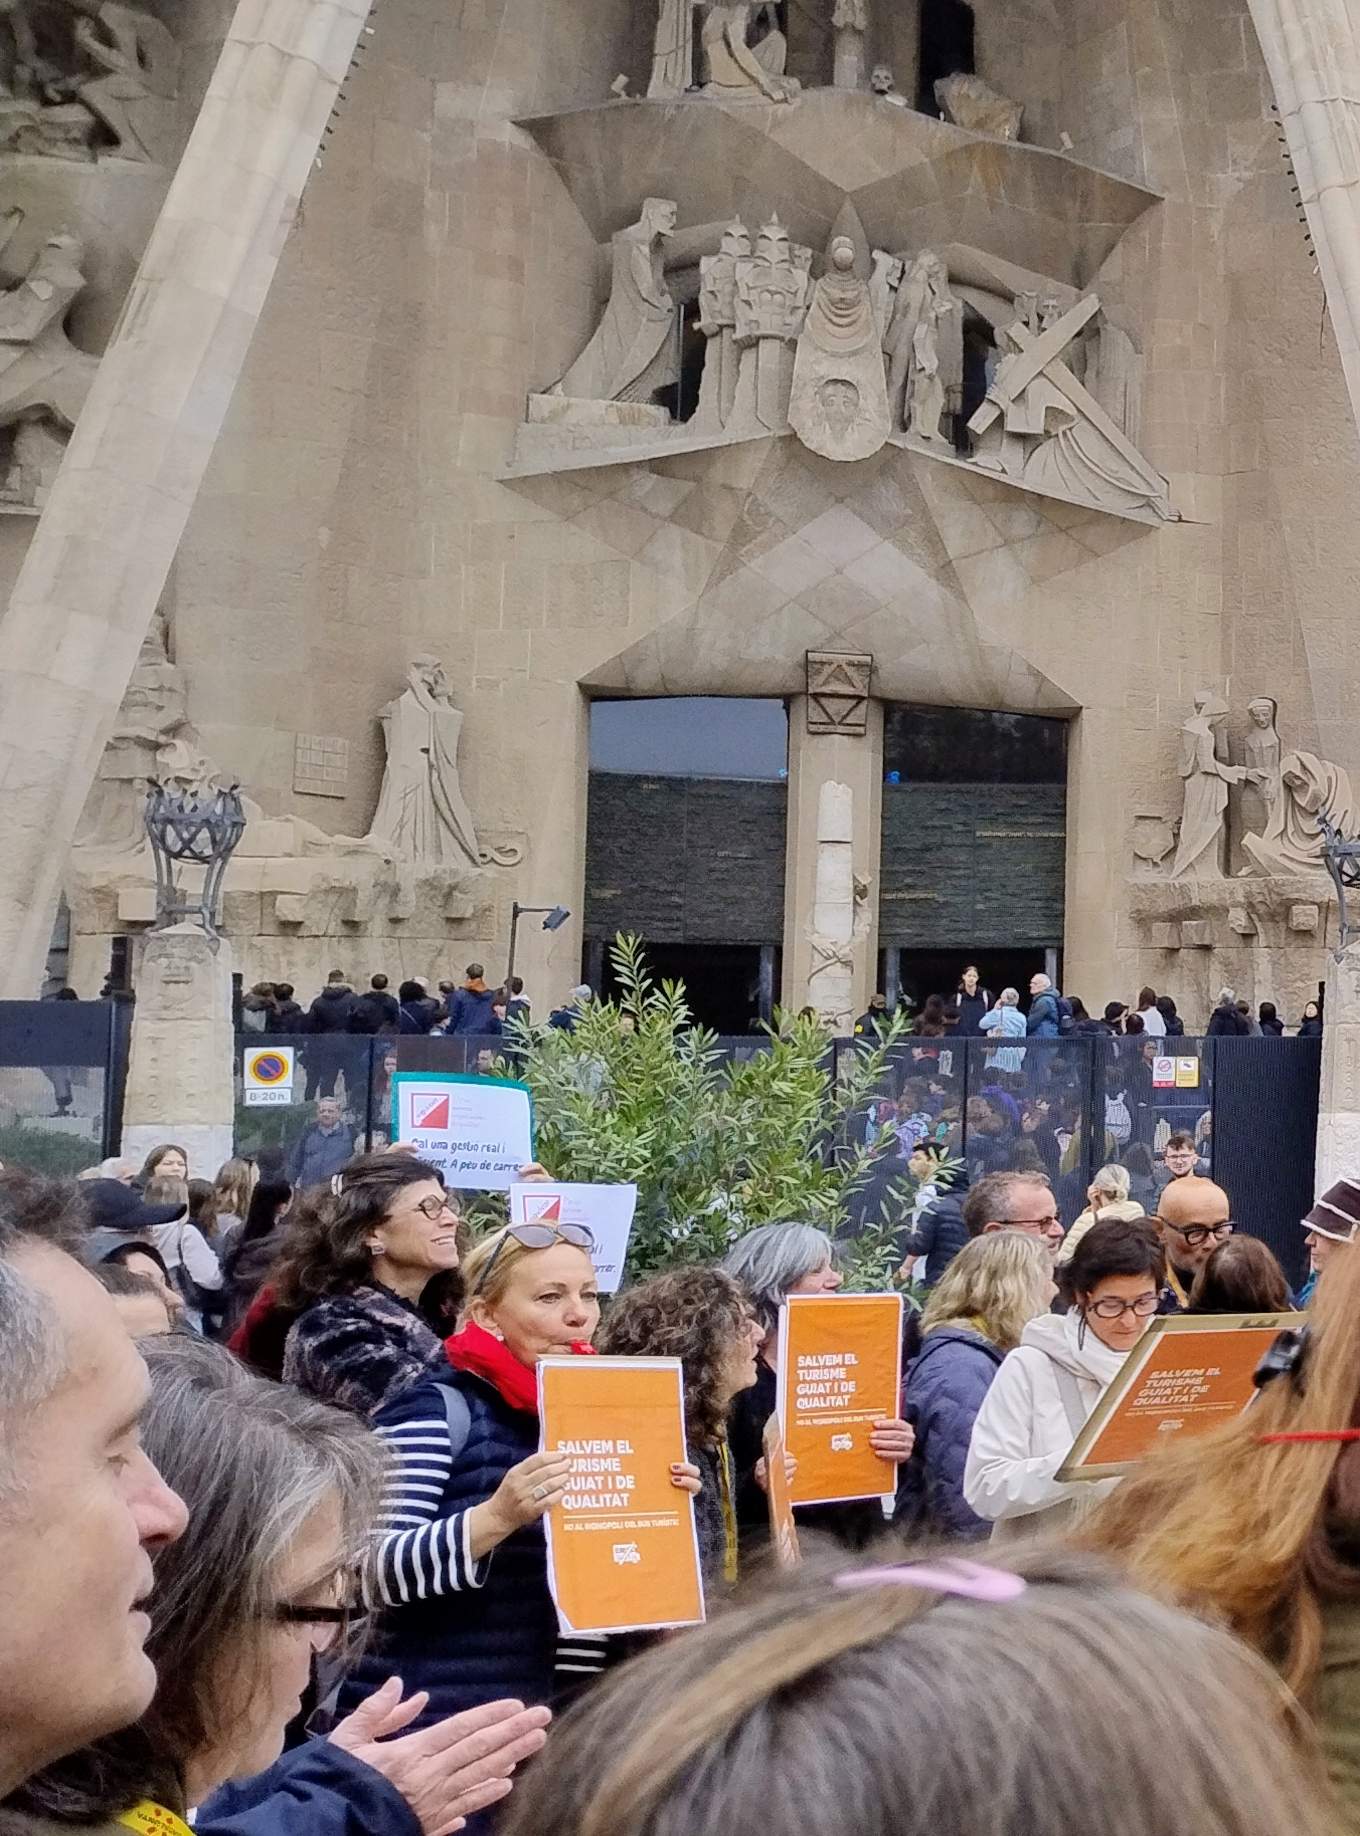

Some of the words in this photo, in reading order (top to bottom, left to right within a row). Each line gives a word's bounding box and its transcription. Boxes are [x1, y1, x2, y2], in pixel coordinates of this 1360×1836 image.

[796, 1353, 843, 1367] SALVEM
[844, 1353, 859, 1365] EL
[796, 1367, 847, 1381] TURISME
[795, 1382, 833, 1396] GUIAT
[840, 1380, 857, 1393] DE
[796, 1394, 851, 1410] QUALITAT
[556, 1439, 614, 1455] SALVEM
[616, 1440, 634, 1454] EL
[608, 1475, 613, 1490] I
[615, 1475, 636, 1489] DE
[561, 1492, 630, 1510] QUALITAT
